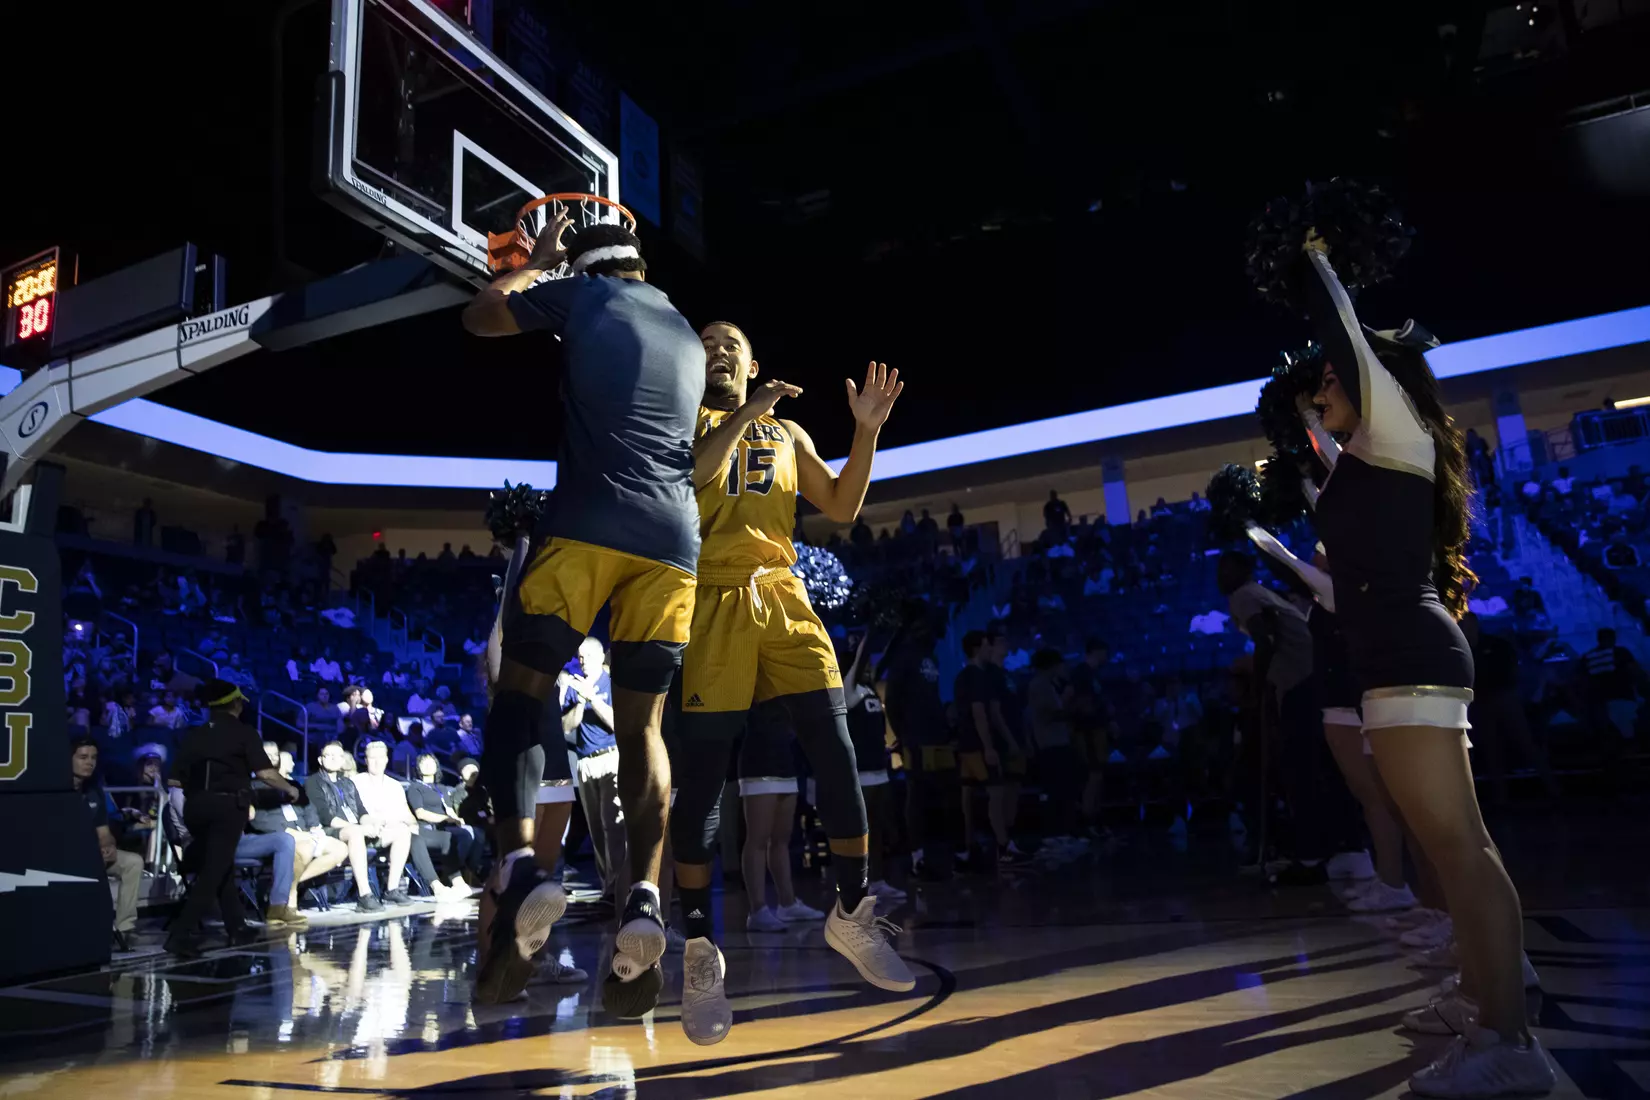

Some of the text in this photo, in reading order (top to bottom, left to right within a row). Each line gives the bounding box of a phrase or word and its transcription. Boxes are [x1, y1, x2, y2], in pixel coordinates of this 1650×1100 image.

[19, 298, 49, 339] 30
[180, 304, 249, 343] SPALDING
[726, 447, 776, 496] 15
